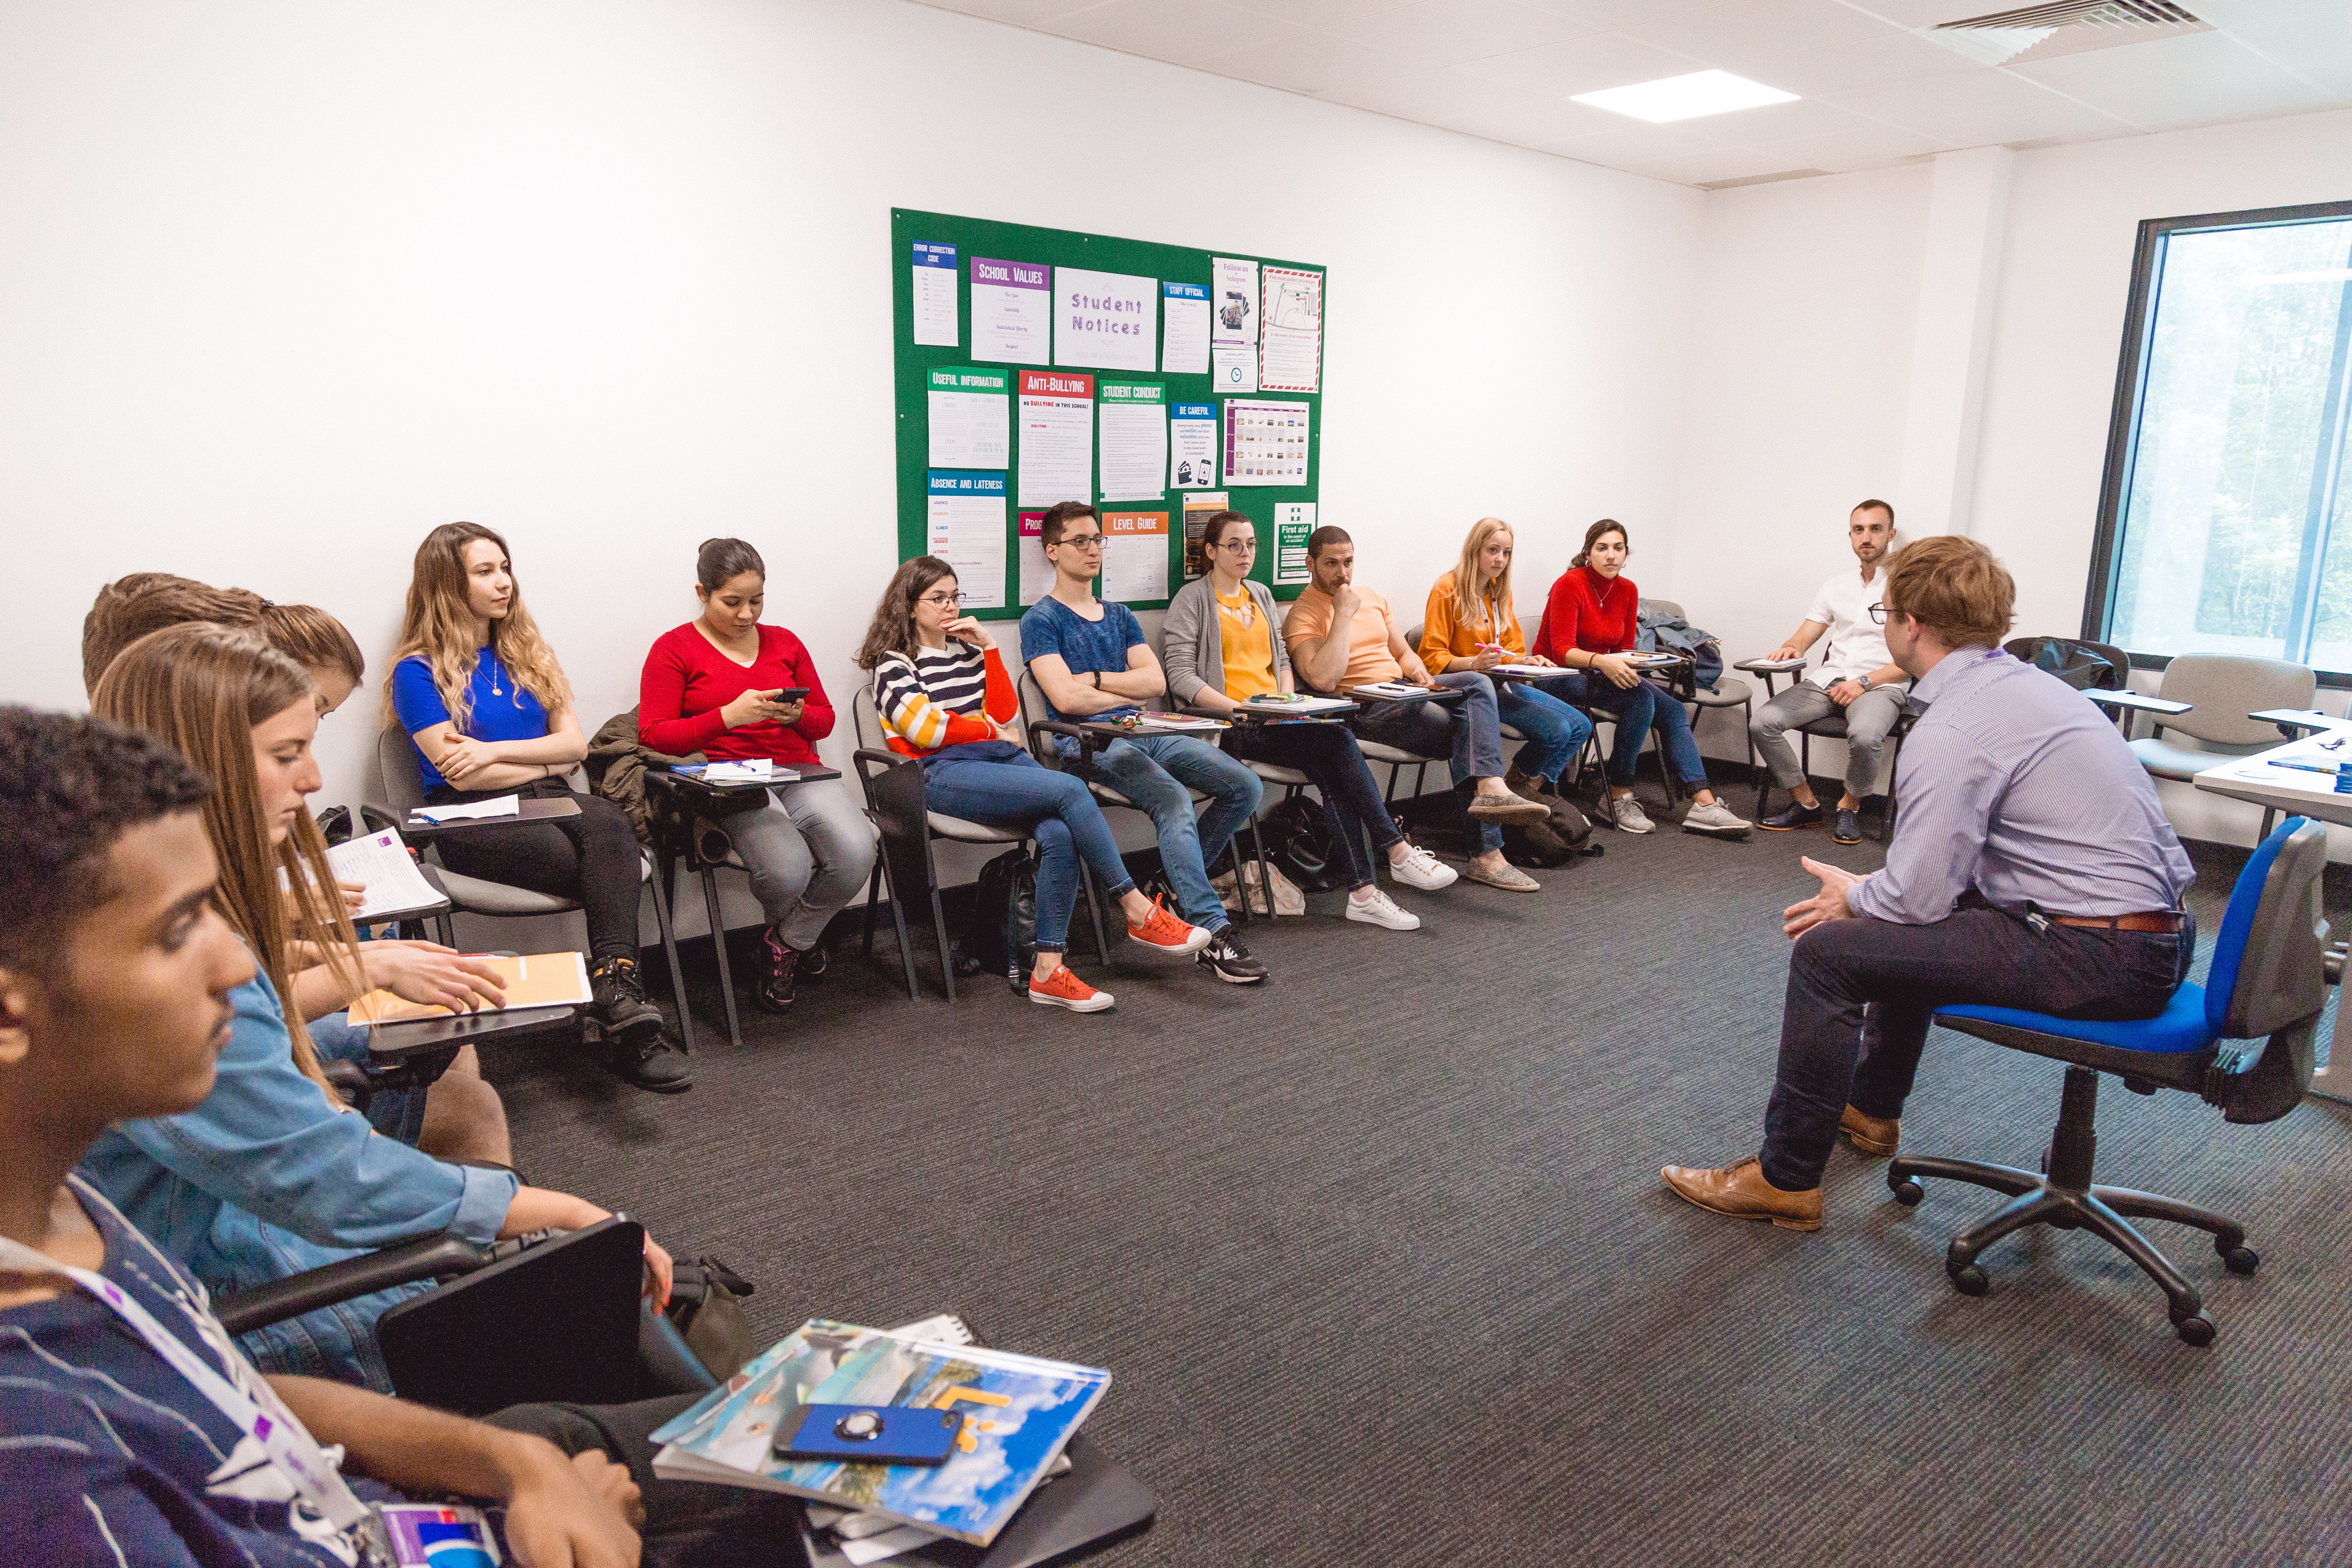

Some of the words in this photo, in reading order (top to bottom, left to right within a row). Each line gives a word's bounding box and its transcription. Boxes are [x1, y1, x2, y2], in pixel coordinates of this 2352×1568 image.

[929, 245, 955, 254] CORRECTION
[979, 263, 1009, 281] SCHOOL
[1013, 267, 1042, 284] VALUES
[1226, 275, 1246, 284] Instagram
[1169, 286, 1183, 295] STAFF
[1185, 287, 1204, 297] OFFICIAL
[1072, 293, 1141, 313] Student
[1073, 316, 1140, 335] Notices
[933, 372, 958, 385] USEFUL
[961, 376, 1003, 388] INFORMATION
[1028, 376, 1085, 393] ANTI-BULLYING
[1103, 385, 1131, 398] STUDENT
[1134, 387, 1161, 399] CONDUCT
[1179, 406, 1186, 415] BE
[1188, 407, 1209, 415] CAREFUL
[931, 477, 957, 488] ABSENCE
[960, 479, 972, 488] AND
[974, 480, 1002, 489] LATENESS
[1113, 518, 1134, 530] LEVEL
[1138, 517, 1157, 530] GUIDE
